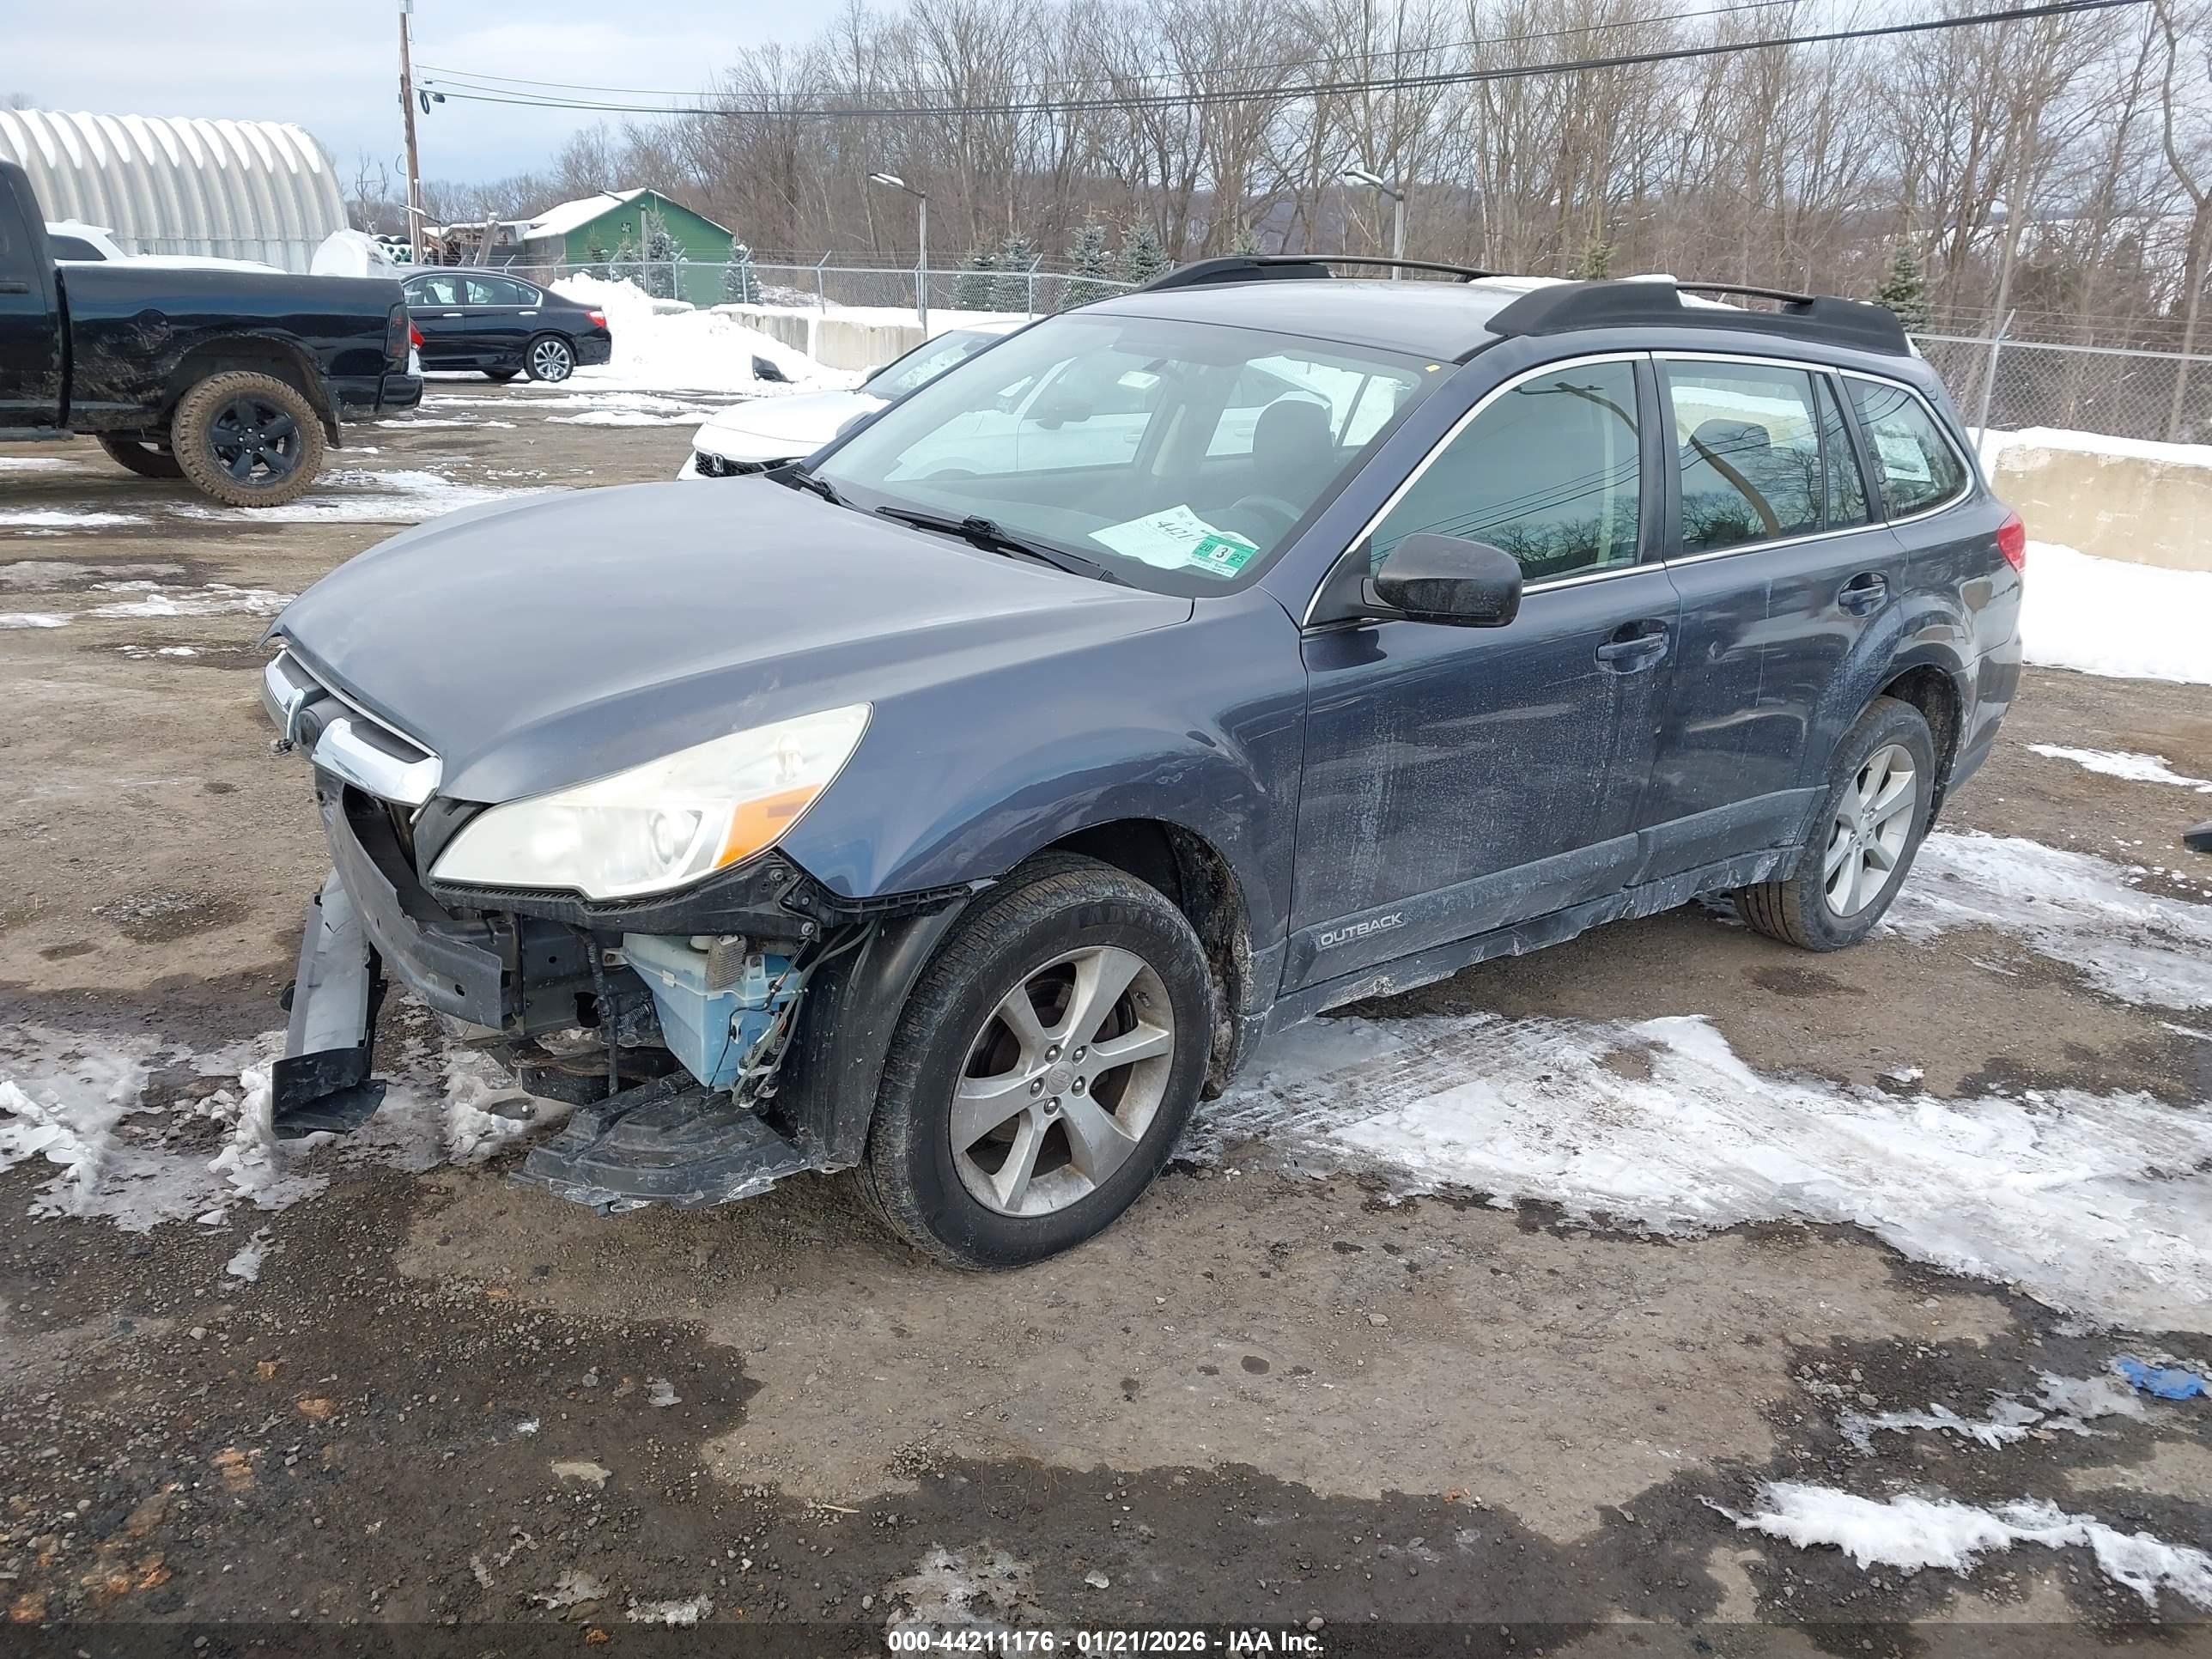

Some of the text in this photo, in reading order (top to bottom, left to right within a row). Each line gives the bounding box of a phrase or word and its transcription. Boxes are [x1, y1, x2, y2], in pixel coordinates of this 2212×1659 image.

[1199, 543, 1213, 552] 20
[1216, 547, 1229, 558] 3
[1231, 554, 1247, 563] 25
[1320, 912, 1403, 946] OUTBACK
